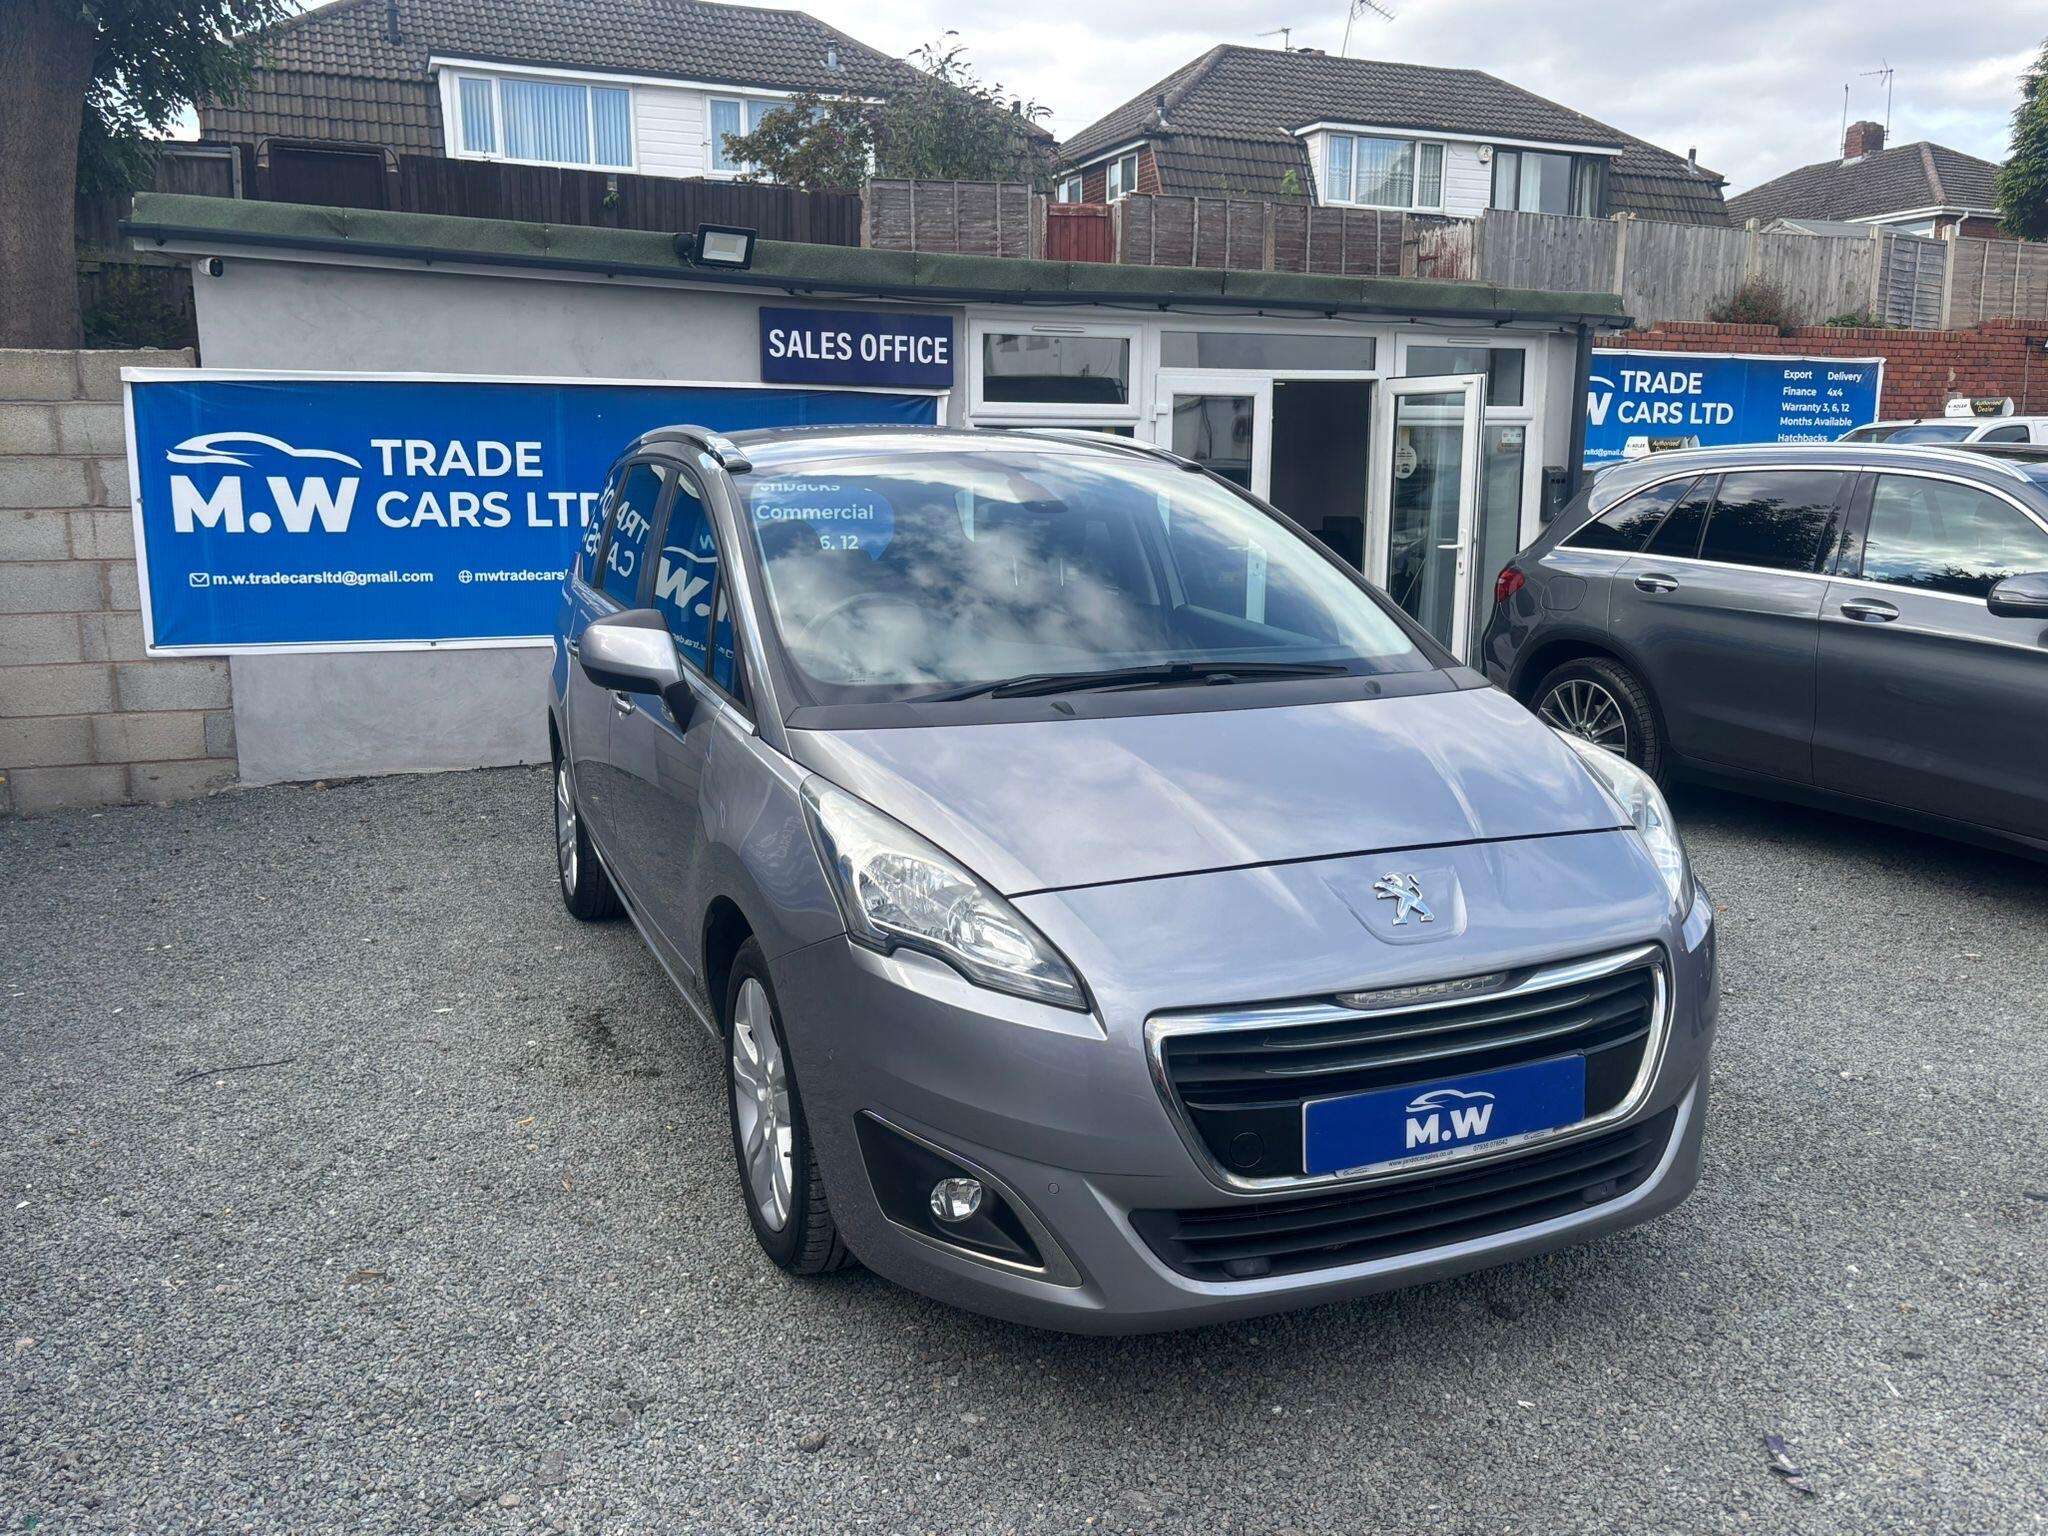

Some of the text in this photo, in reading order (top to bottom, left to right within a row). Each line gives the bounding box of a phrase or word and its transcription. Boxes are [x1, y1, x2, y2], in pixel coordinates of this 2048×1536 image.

[769, 329, 948, 364] SALES OFFICE
[1620, 370, 1703, 394] TRADE
[1784, 370, 1862, 382] Export Delivery
[1783, 386, 1843, 397] Finance 4x4
[1617, 401, 1734, 425] CARS LTD
[1781, 402, 1850, 413] Warranty 3, 6, 12
[1780, 416, 1853, 426] Months Available
[1777, 433, 1828, 443] Hatchbacks
[370, 438, 543, 478] TRADE
[169, 474, 360, 534] M.W
[376, 491, 512, 528] CARS
[756, 503, 874, 520] Commercial
[840, 534, 859, 550] 12
[213, 570, 434, 586] m.w.tradecarsltd@gmail.com
[1406, 1103, 1493, 1149] M.W
